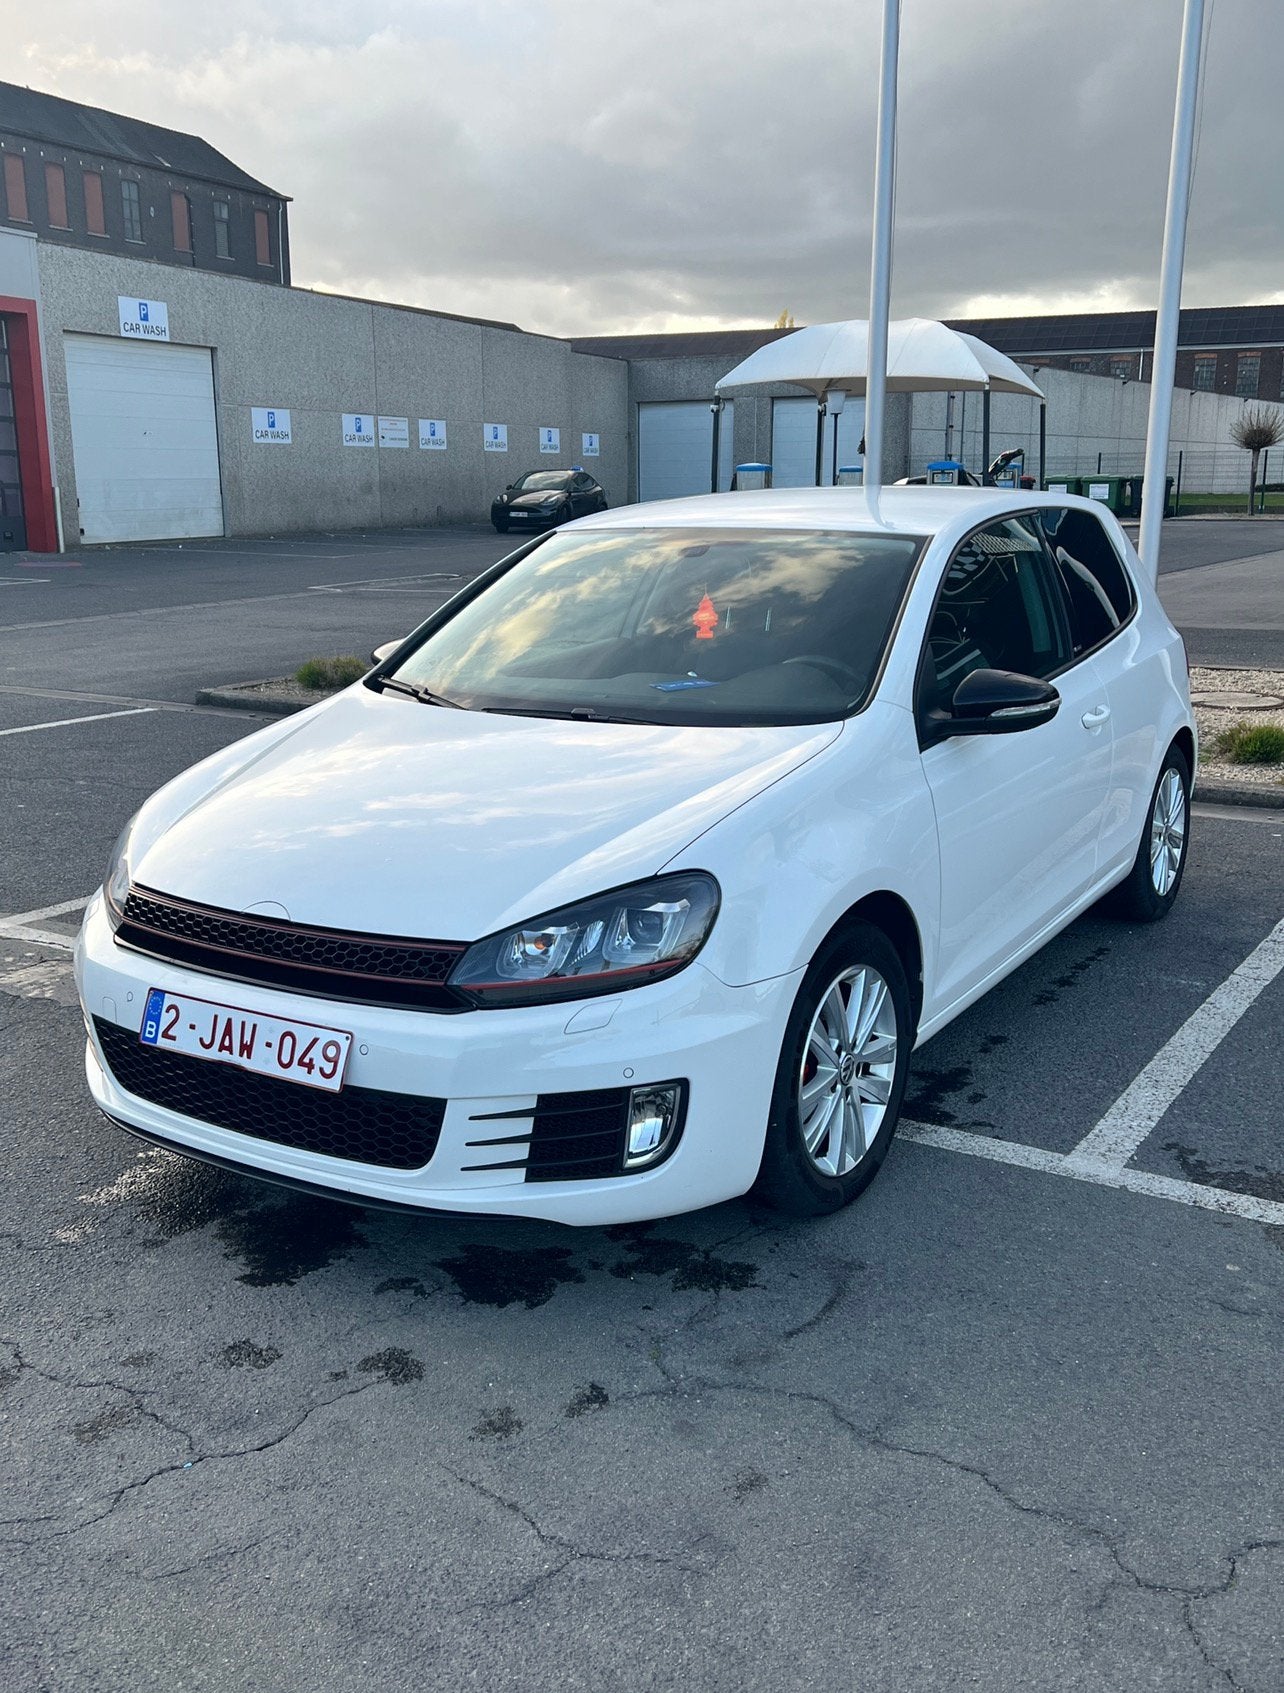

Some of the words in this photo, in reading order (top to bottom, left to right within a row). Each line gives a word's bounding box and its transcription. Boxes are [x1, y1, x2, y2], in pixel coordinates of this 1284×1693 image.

[140, 304, 148, 320] P
[123, 322, 141, 334] CAR
[143, 324, 167, 336] WASH
[268, 413, 274, 426] P
[356, 418, 361, 431] P
[255, 430, 269, 438] CAR
[270, 430, 290, 440] WASH
[344, 434, 356, 442] CAR
[357, 434, 373, 442] WASH
[145, 1020, 157, 1038] B
[161, 1004, 342, 1079] 2-JAW-049
